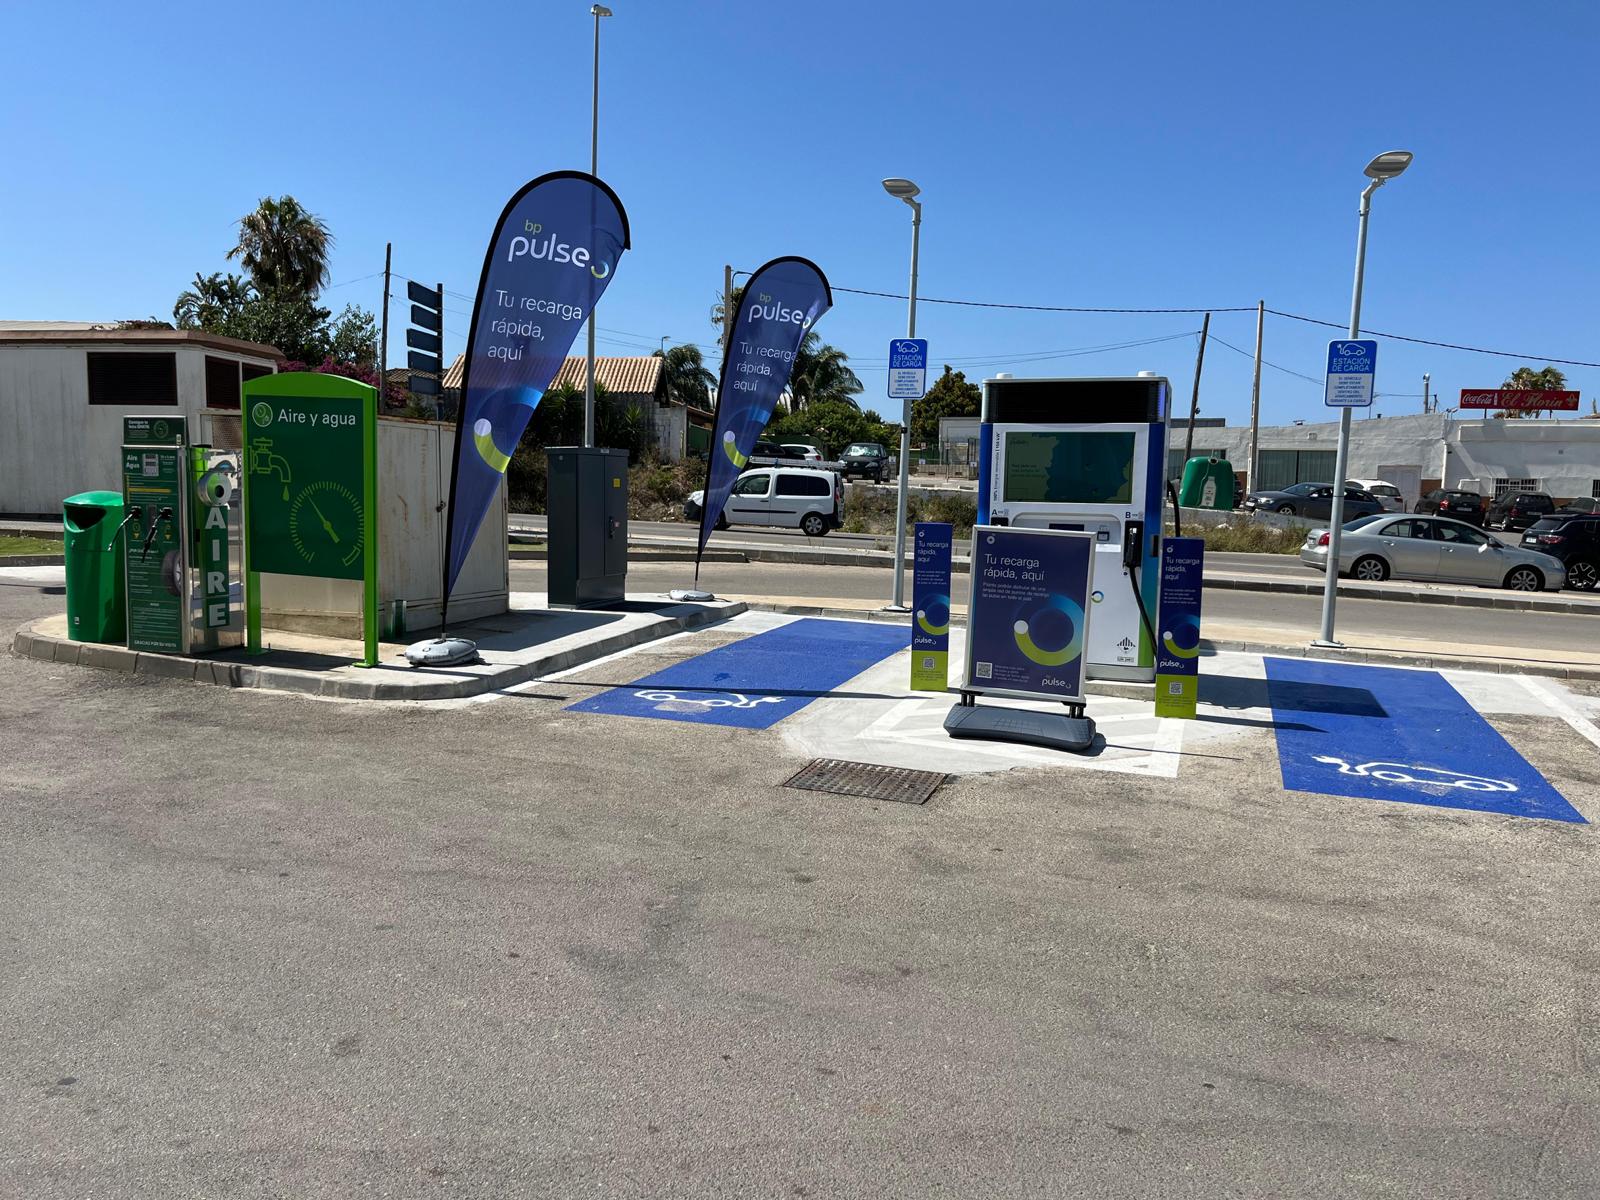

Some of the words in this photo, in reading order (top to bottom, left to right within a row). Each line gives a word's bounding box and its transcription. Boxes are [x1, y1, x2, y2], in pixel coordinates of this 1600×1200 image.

[524, 219, 542, 235] bp
[508, 233, 590, 268] pulse
[496, 289, 514, 308] Tu
[520, 297, 583, 320] recarga
[759, 292, 772, 304] bp
[748, 301, 804, 325] pulse
[491, 317, 545, 341] rápida,
[487, 345, 524, 362] aquí
[739, 341, 753, 355] Tu
[736, 360, 773, 377] rápida,
[1332, 364, 1343, 372] DE
[1343, 364, 1370, 372] CARGA
[733, 379, 759, 392] aquí
[1500, 392, 1520, 408] El
[277, 408, 306, 424] Aire
[309, 413, 318, 427] y
[322, 413, 356, 428] agua
[126, 462, 140, 470] Agua
[1125, 511, 1131, 519] B
[916, 540, 925, 548] Tu
[205, 507, 227, 627] AIRE
[984, 553, 997, 565] Tu
[1000, 557, 1040, 569] recarga
[1175, 558, 1200, 566] recarga
[983, 567, 1018, 580] rápida,
[1021, 570, 1045, 582] aquí
[914, 637, 933, 645] pulse
[1160, 660, 1180, 668] pulse
[1041, 677, 1066, 687] pulse
